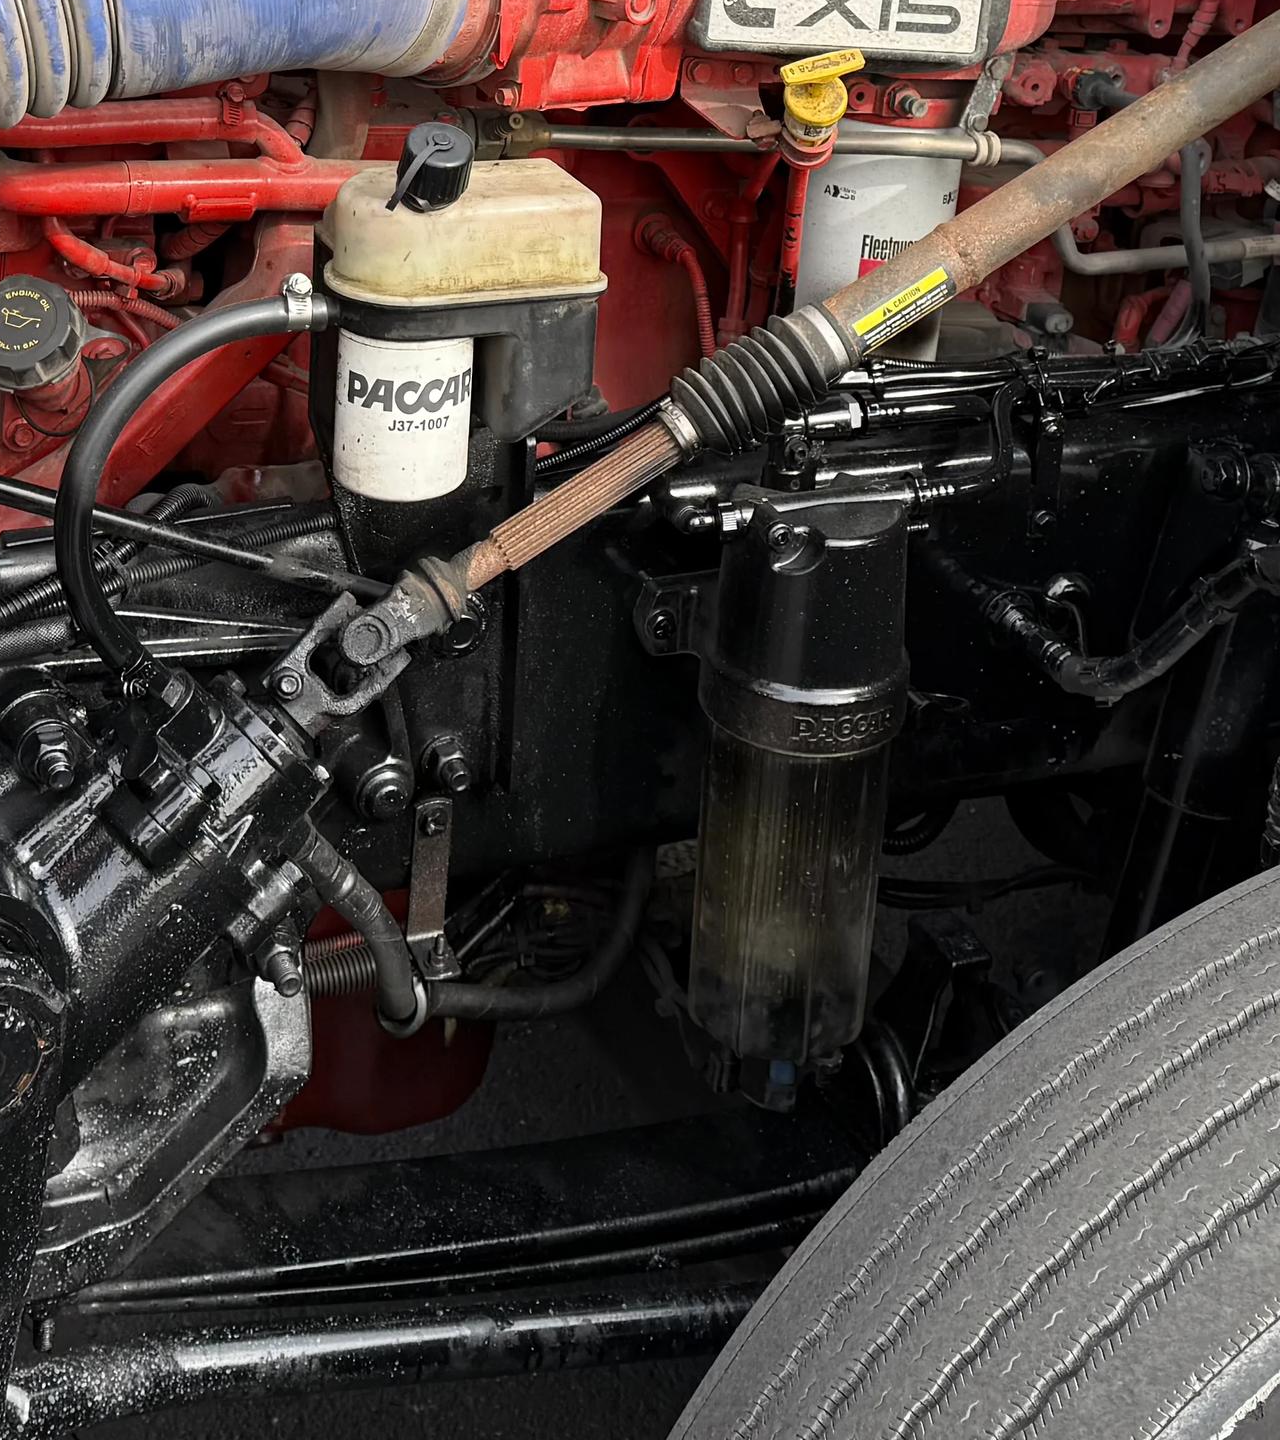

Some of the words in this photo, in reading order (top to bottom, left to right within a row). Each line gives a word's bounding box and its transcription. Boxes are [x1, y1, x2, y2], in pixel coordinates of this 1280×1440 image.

[824, 184, 831, 195] A
[5, 290, 40, 300] ENGINE
[39, 299, 51, 312] OIL
[893, 286, 921, 308] CAUTION
[23, 339, 38, 349] GAL
[347, 367, 471, 414] PACCAR
[388, 416, 450, 432] J37-1007
